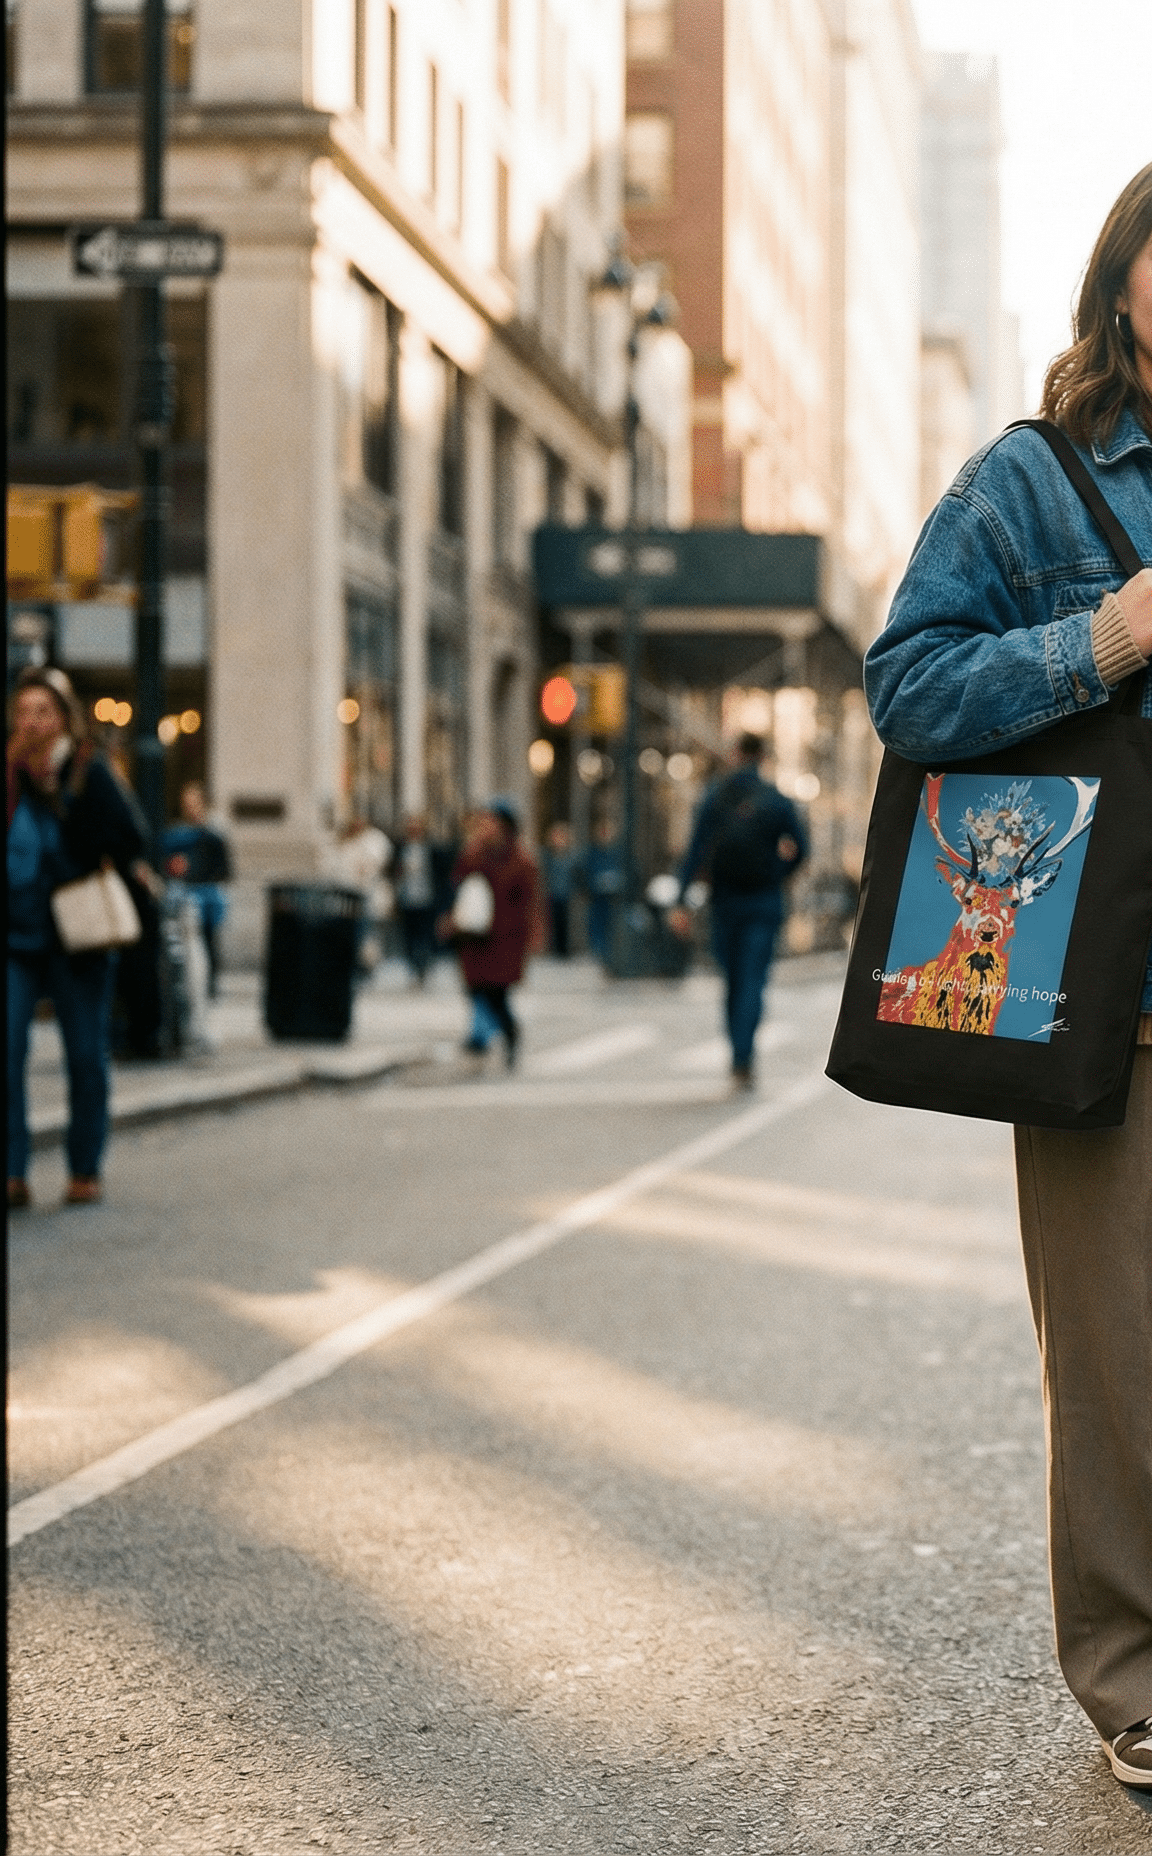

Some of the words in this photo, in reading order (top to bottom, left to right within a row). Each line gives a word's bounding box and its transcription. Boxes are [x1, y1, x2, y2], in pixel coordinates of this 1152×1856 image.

[871, 968, 918, 986] Gude
[973, 983, 1029, 1003] rrying
[1031, 986, 1067, 1006] hope
